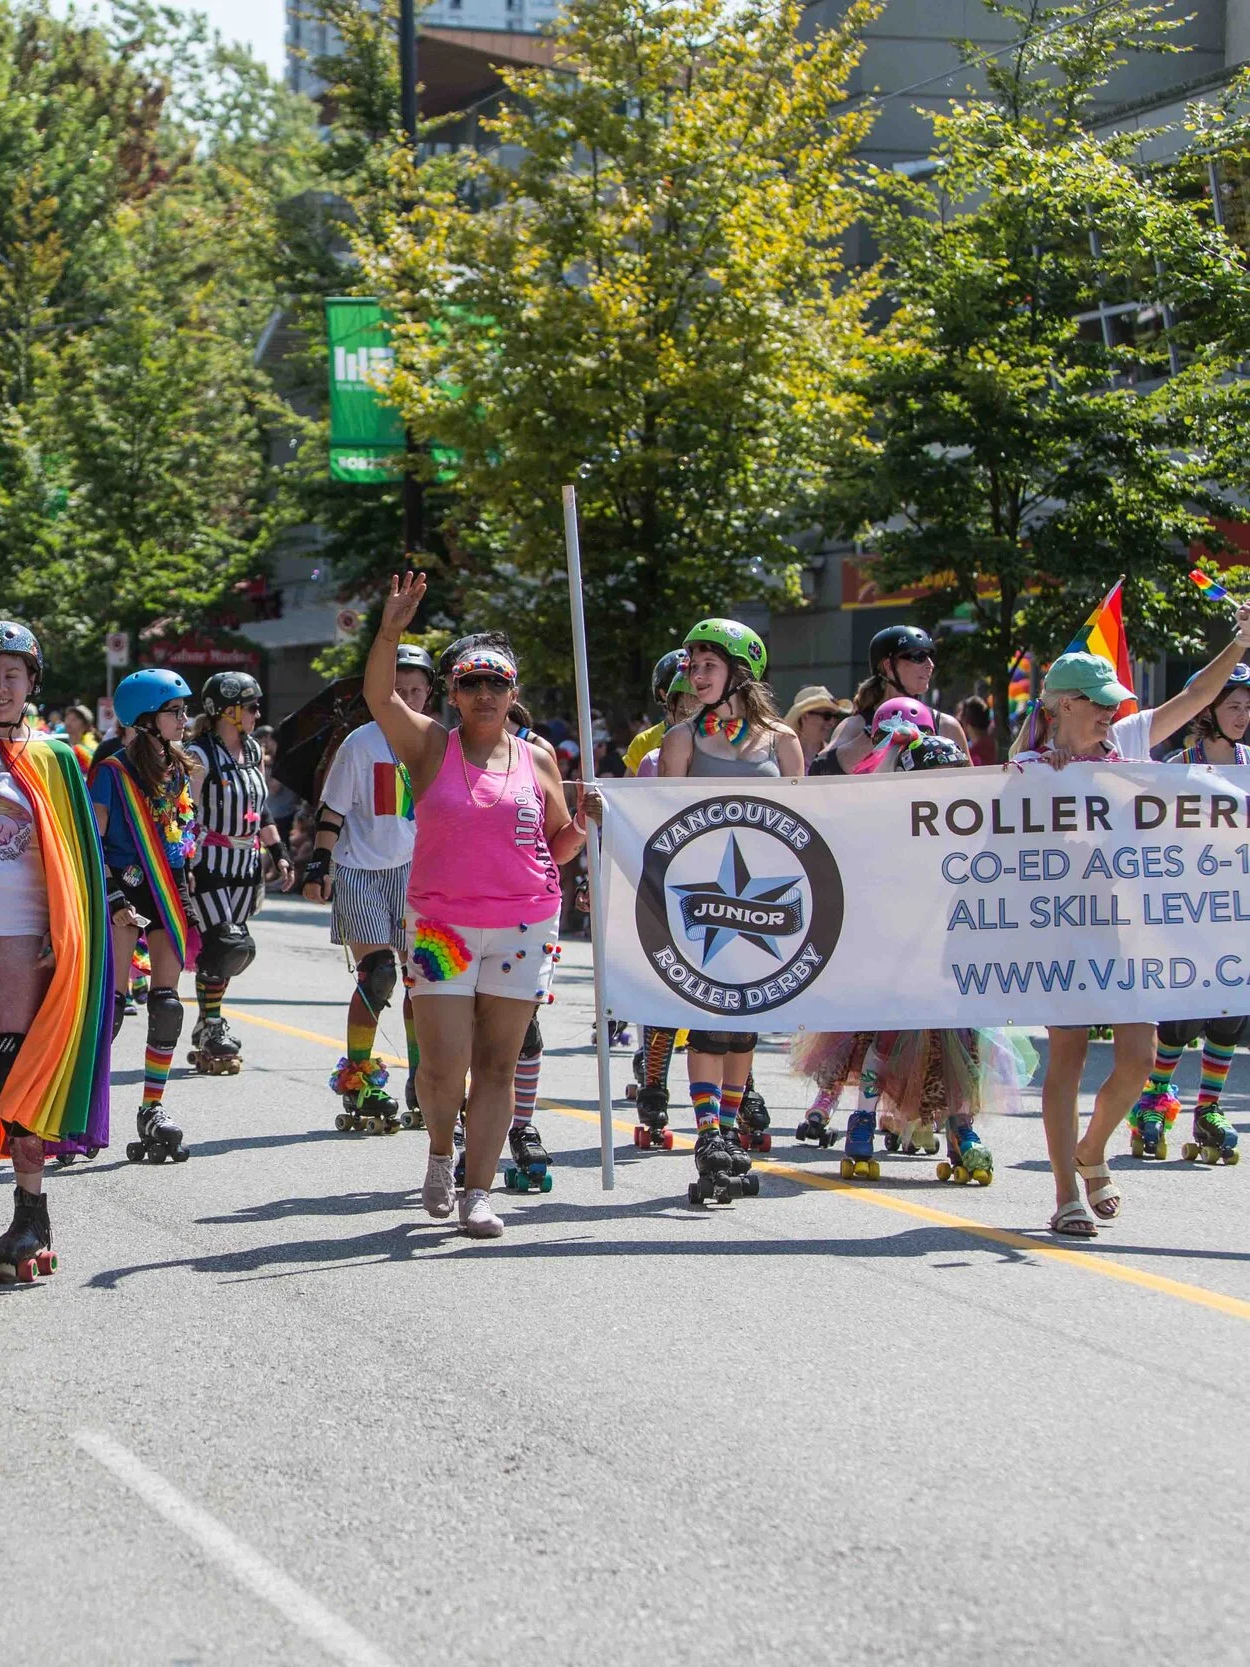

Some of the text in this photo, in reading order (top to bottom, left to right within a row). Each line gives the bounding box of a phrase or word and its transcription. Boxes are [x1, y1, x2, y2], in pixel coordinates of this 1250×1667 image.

[651, 801, 812, 856] VANCOUVER
[911, 794, 1250, 837] ROLLER DER
[942, 844, 1250, 885] CO-ED AGES 6-1
[694, 902, 786, 926] JUNIOR
[947, 890, 1250, 931] ALL SKILL LEVEL
[652, 943, 823, 1009] ROLLER DERBY
[952, 954, 1250, 995] WWW.VJRD.C
